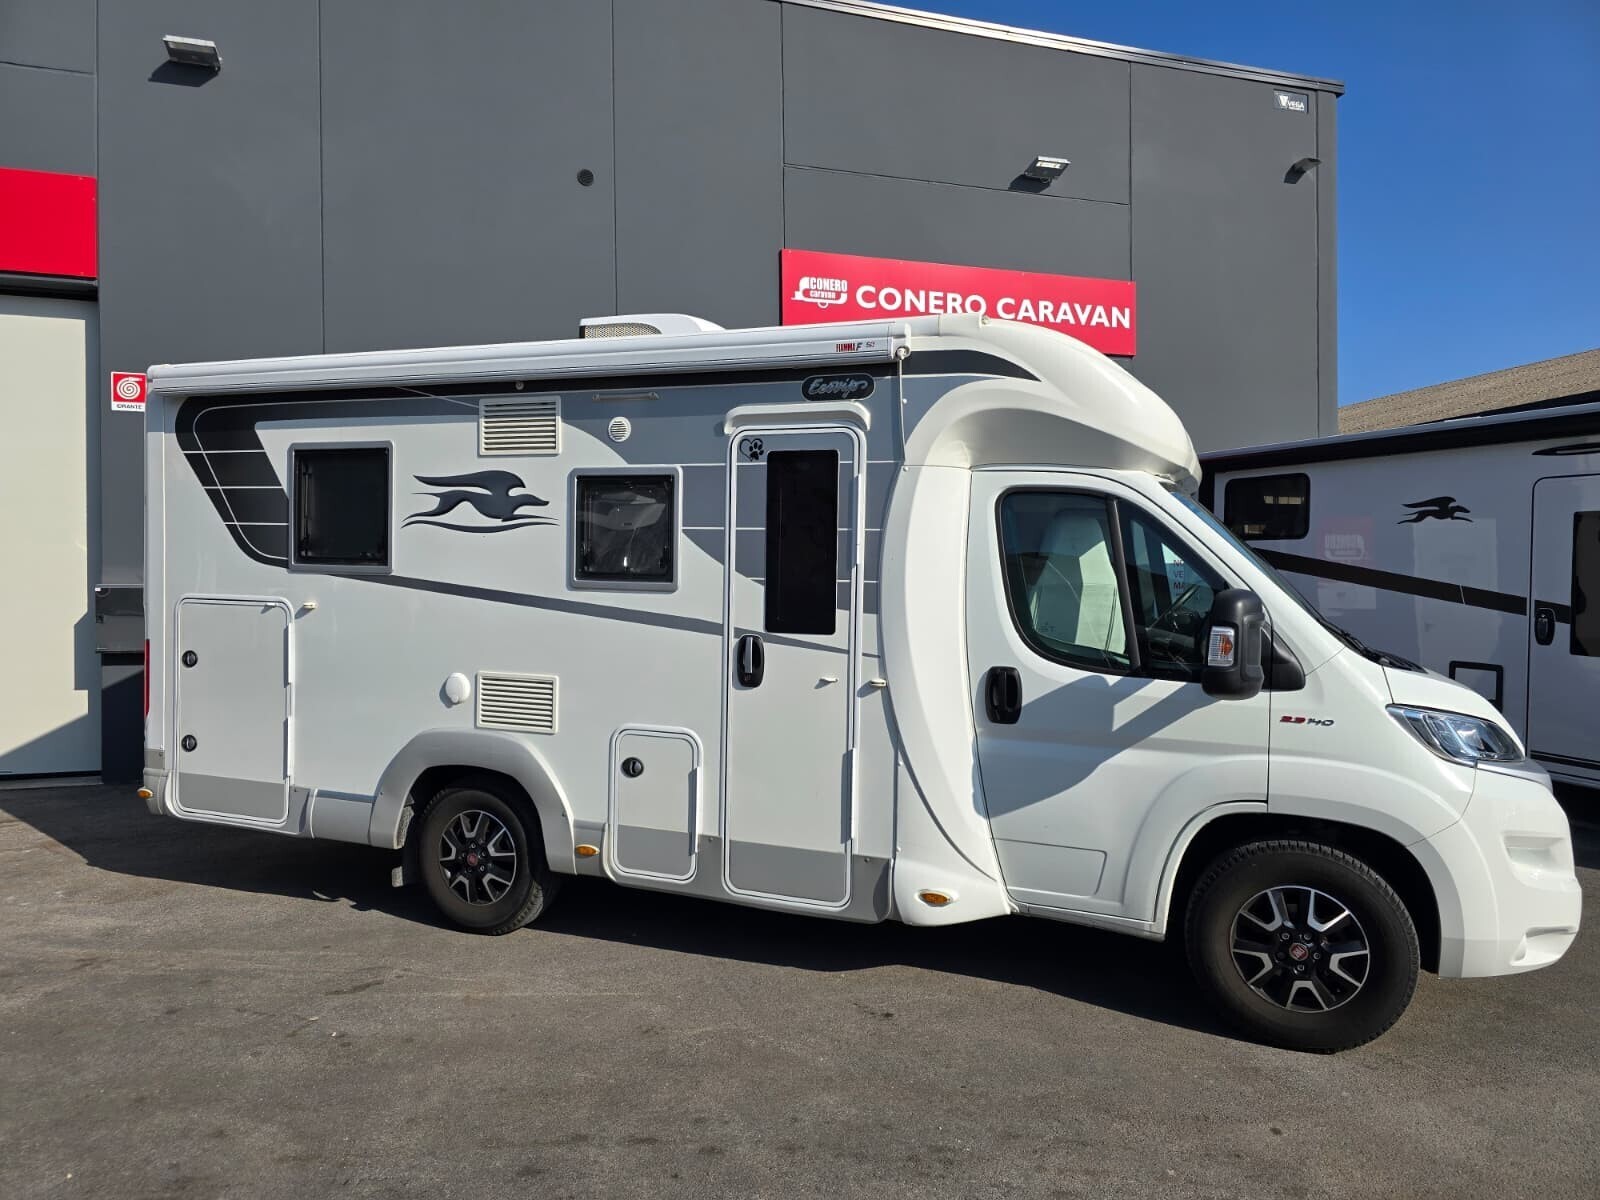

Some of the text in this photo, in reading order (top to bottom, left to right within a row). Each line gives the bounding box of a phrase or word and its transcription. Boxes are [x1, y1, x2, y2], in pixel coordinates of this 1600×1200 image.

[810, 276, 848, 292] CONERO
[855, 284, 1130, 329] CONERO CARAVAN
